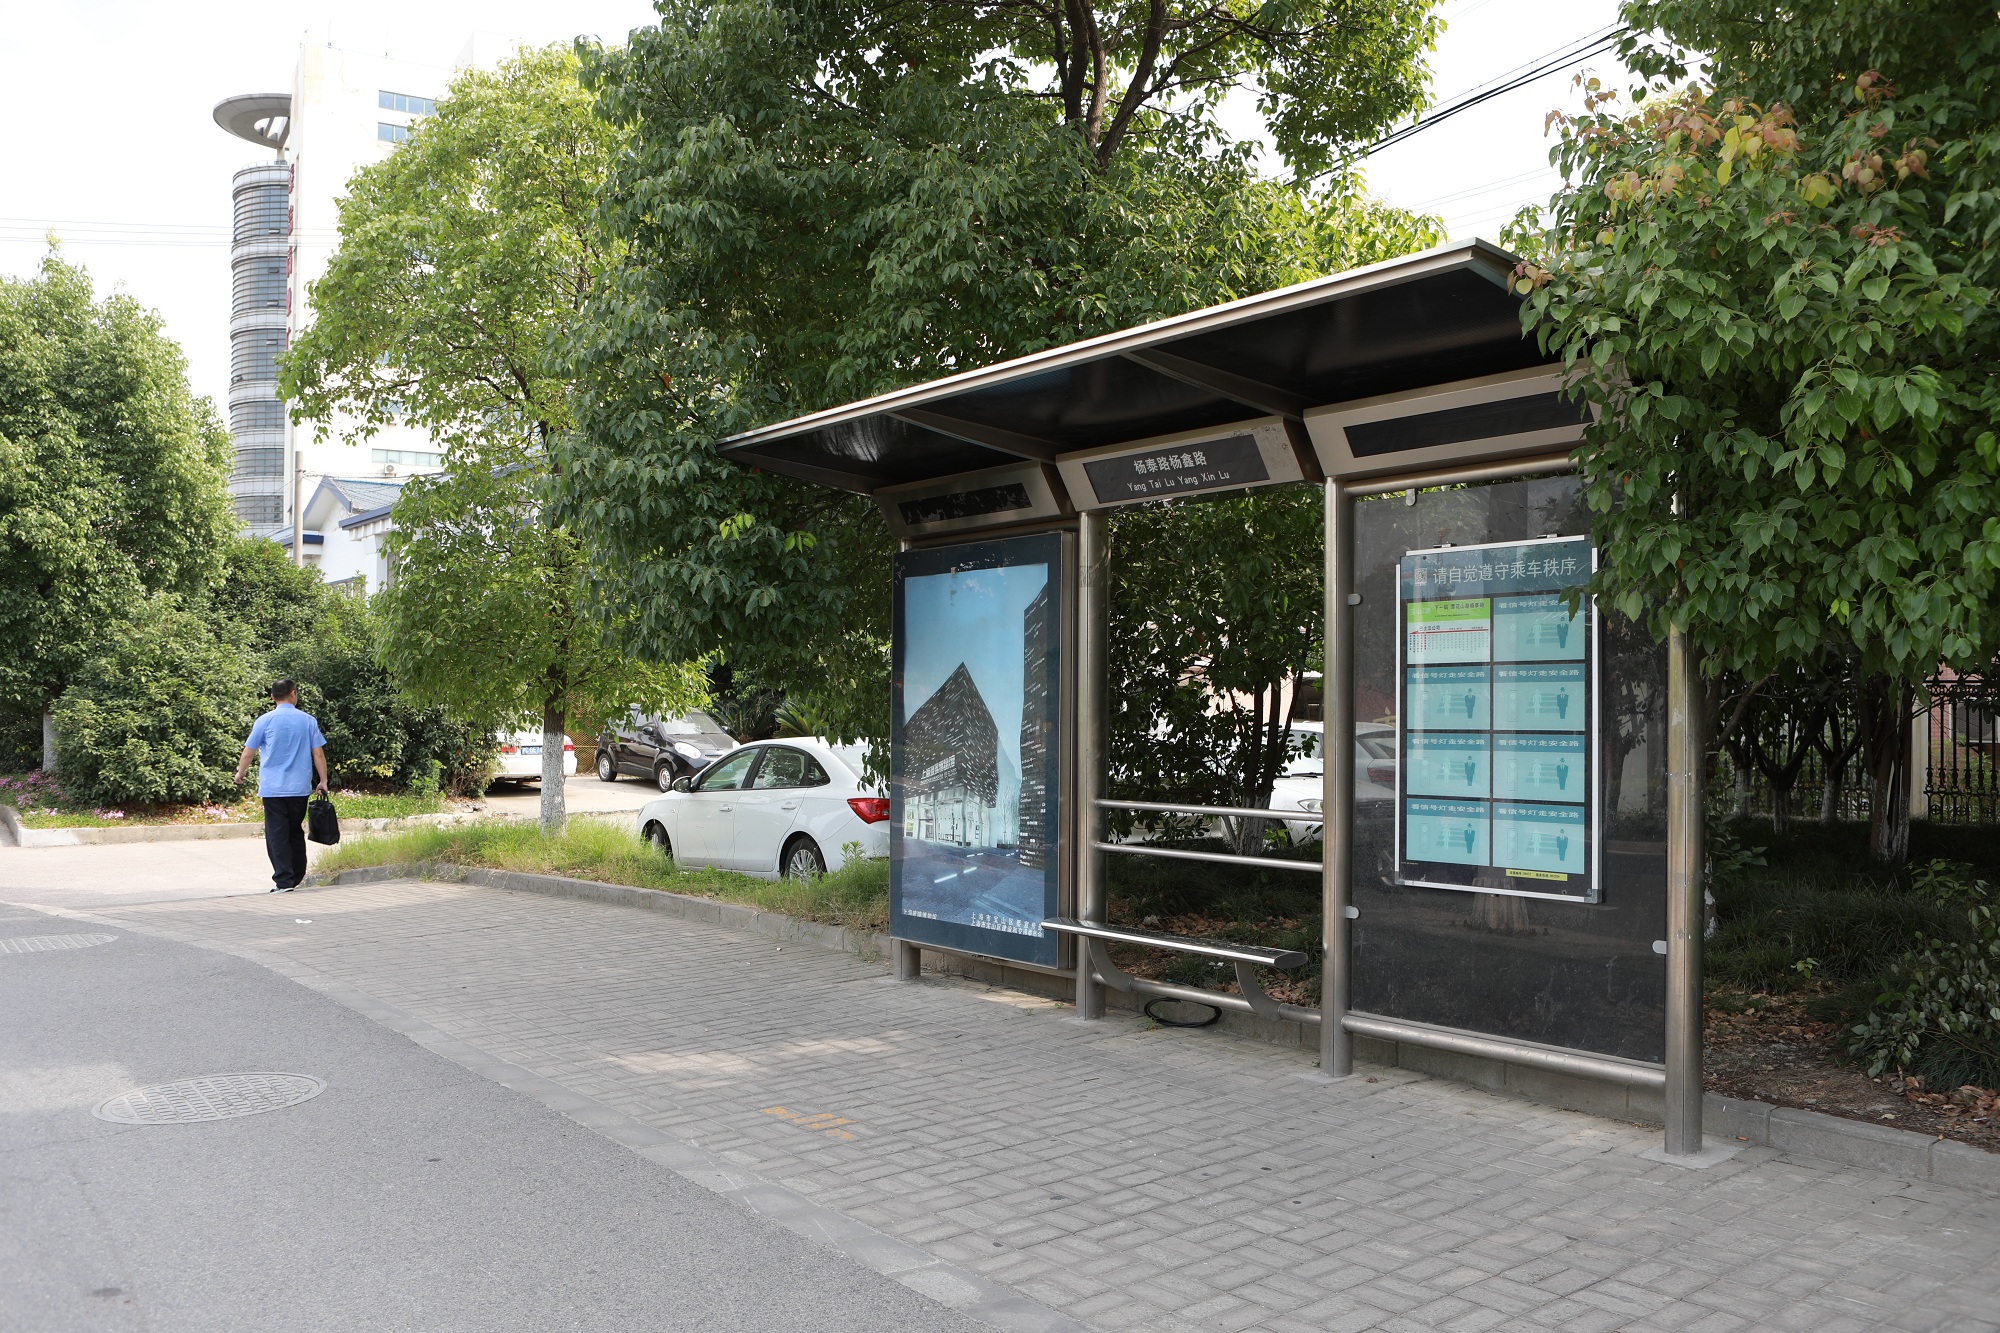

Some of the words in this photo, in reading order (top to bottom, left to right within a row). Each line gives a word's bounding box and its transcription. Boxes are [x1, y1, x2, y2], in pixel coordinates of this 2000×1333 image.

[1133, 450, 1208, 475] 杨泰路杨鑫路
[1127, 482, 1147, 493] Yang
[1148, 479, 1162, 489] Tai
[1164, 477, 1175, 487] Lu
[1177, 475, 1199, 486] Yang
[1201, 472, 1216, 482] Xin
[1219, 470, 1230, 480] Lu
[1433, 557, 1577, 585] 请自觉遵守乘车秩序
[1411, 671, 1486, 679] 看信号灯走安全路
[1498, 669, 1580, 678] 看信号灯走安全路
[1411, 738, 1486, 746] 看信号灯走安全路
[1498, 739, 1580, 748] 看信号灯走安全路
[1410, 803, 1486, 814] 看信号灯走安全路
[1498, 807, 1580, 819] 看信号灯走安全路
